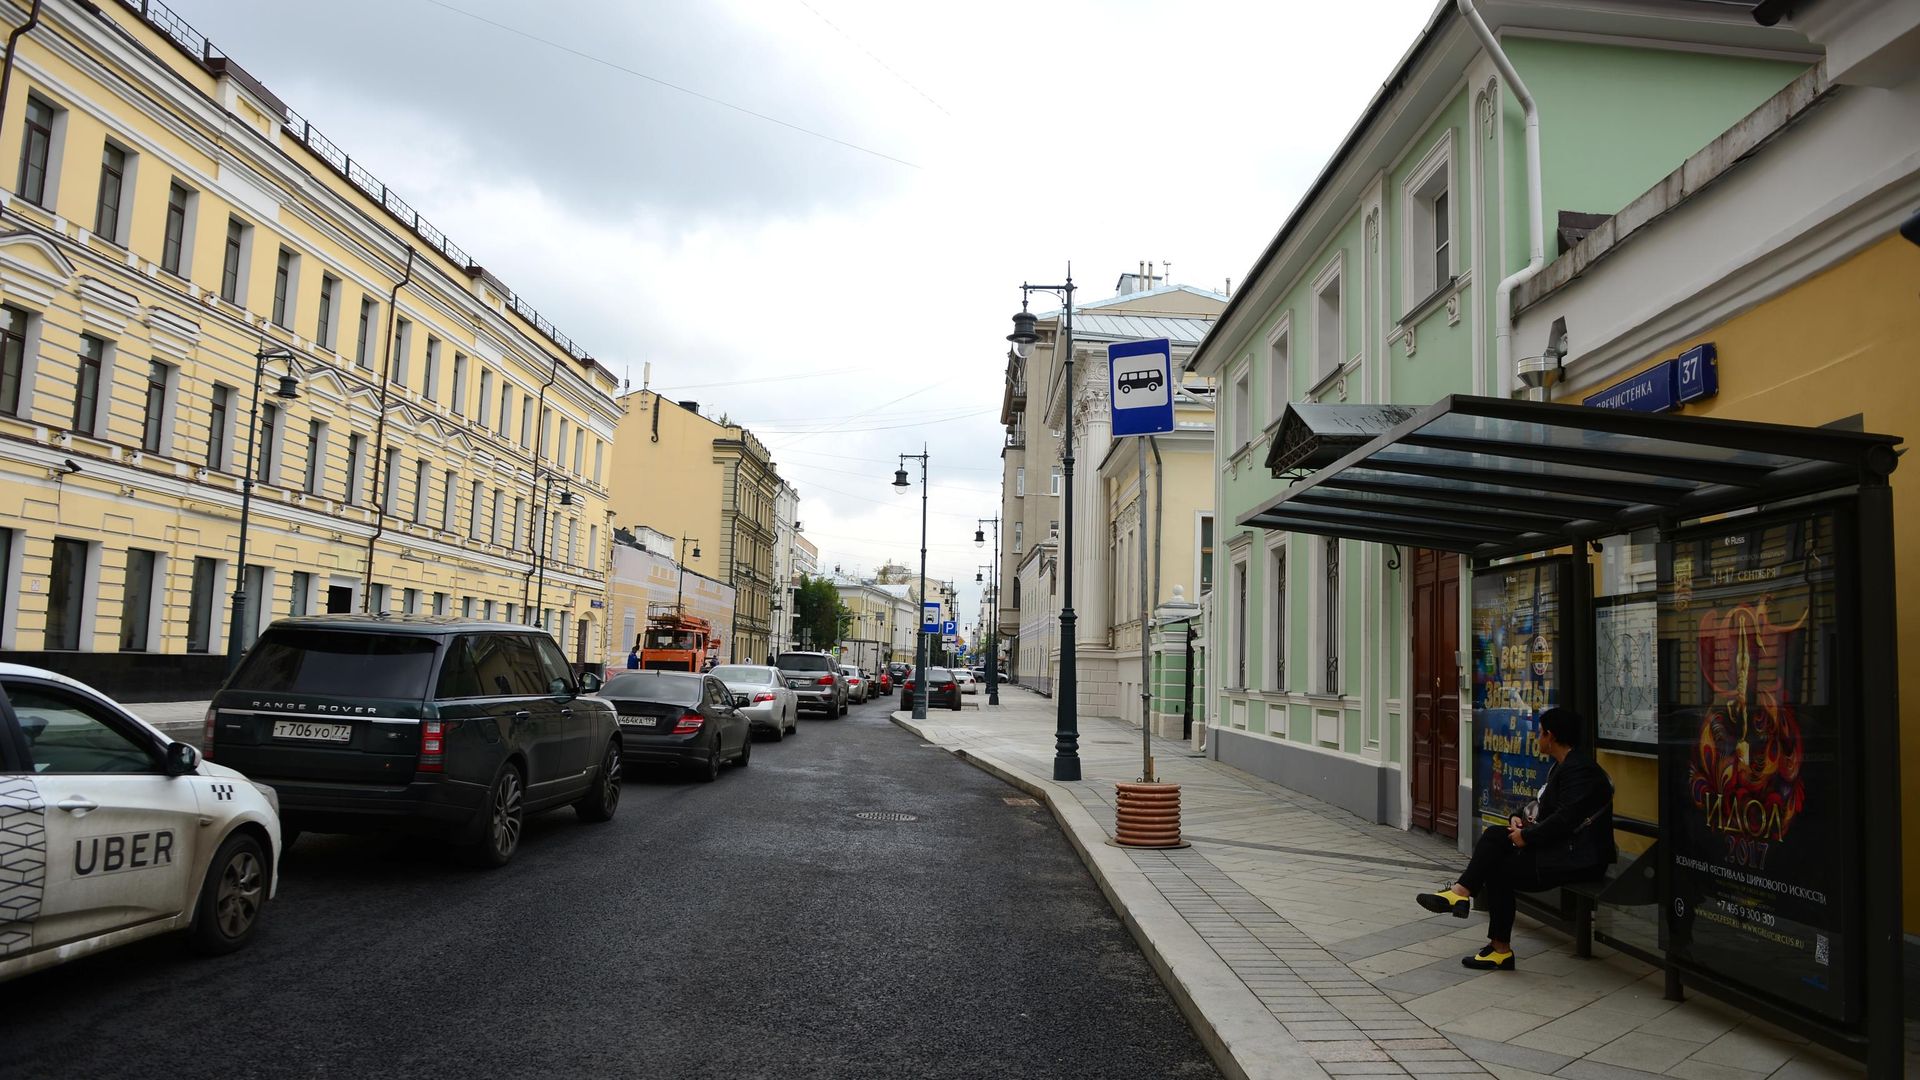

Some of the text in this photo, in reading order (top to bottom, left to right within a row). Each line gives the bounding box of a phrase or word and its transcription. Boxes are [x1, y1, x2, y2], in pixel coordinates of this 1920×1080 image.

[1682, 357, 1698, 384] 37
[1737, 567, 1777, 582] СЕНТЯБРЯ
[945, 622, 955, 634] P
[1501, 644, 1528, 670] ВСЕ
[252, 701, 377, 714] RANGE ROVER
[1483, 727, 1522, 754] Новый
[1705, 792, 1784, 843] ИДОЛ
[75, 831, 173, 875] UBER
[1725, 834, 1769, 871] 2017
[1675, 854, 1708, 872] ВСЕМИРНЫЙ
[1709, 864, 1745, 882] ФЕСТИВАЛЬ
[1746, 873, 1788, 894] ЦИРКОВОГО
[1788, 884, 1827, 905] ИСКУССТВА
[1716, 900, 1726, 911] +7
[1727, 902, 1739, 915] 495
[1739, 906, 1745, 917] 9
[1746, 908, 1761, 922] 300
